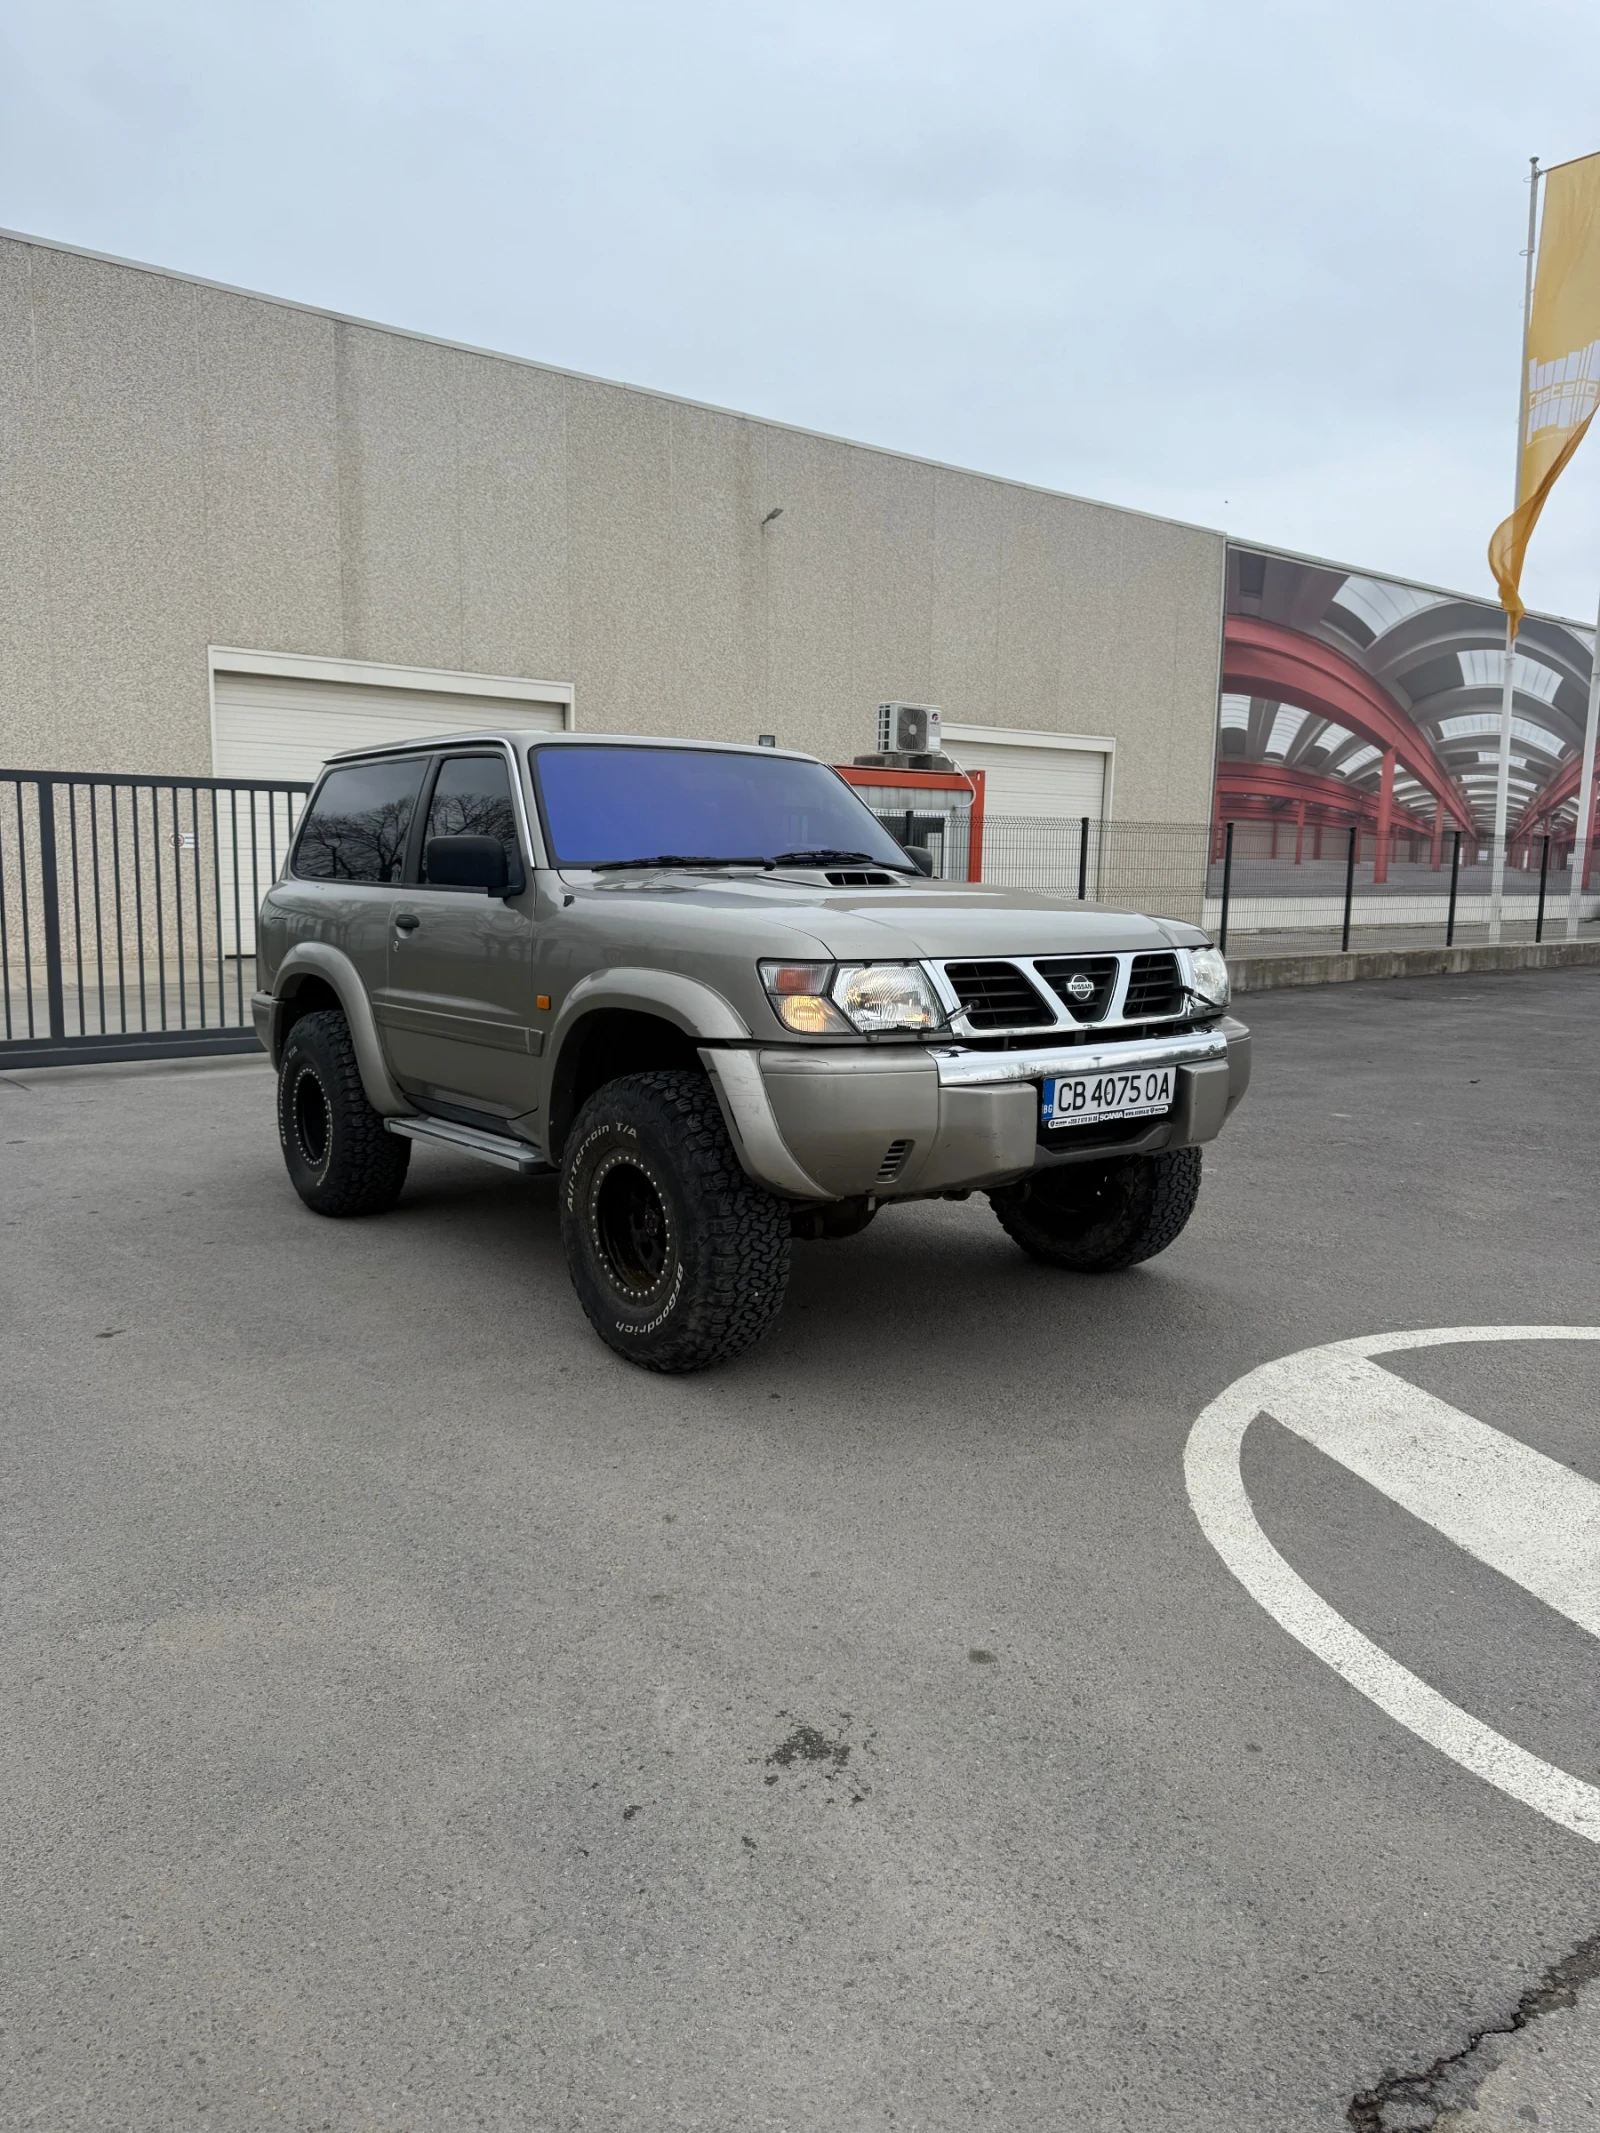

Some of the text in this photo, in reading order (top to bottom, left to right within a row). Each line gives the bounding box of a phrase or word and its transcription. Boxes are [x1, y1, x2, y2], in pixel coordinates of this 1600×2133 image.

[1071, 983, 1092, 991] NISSAN
[1058, 1081, 1086, 1112] CB
[1091, 1075, 1141, 1107] 4075
[1043, 1104, 1053, 1114] BG
[1099, 1110, 1123, 1121] SCANIA
[615, 1121, 638, 1139] T/A
[615, 1261, 684, 1336] BFGoodrich
